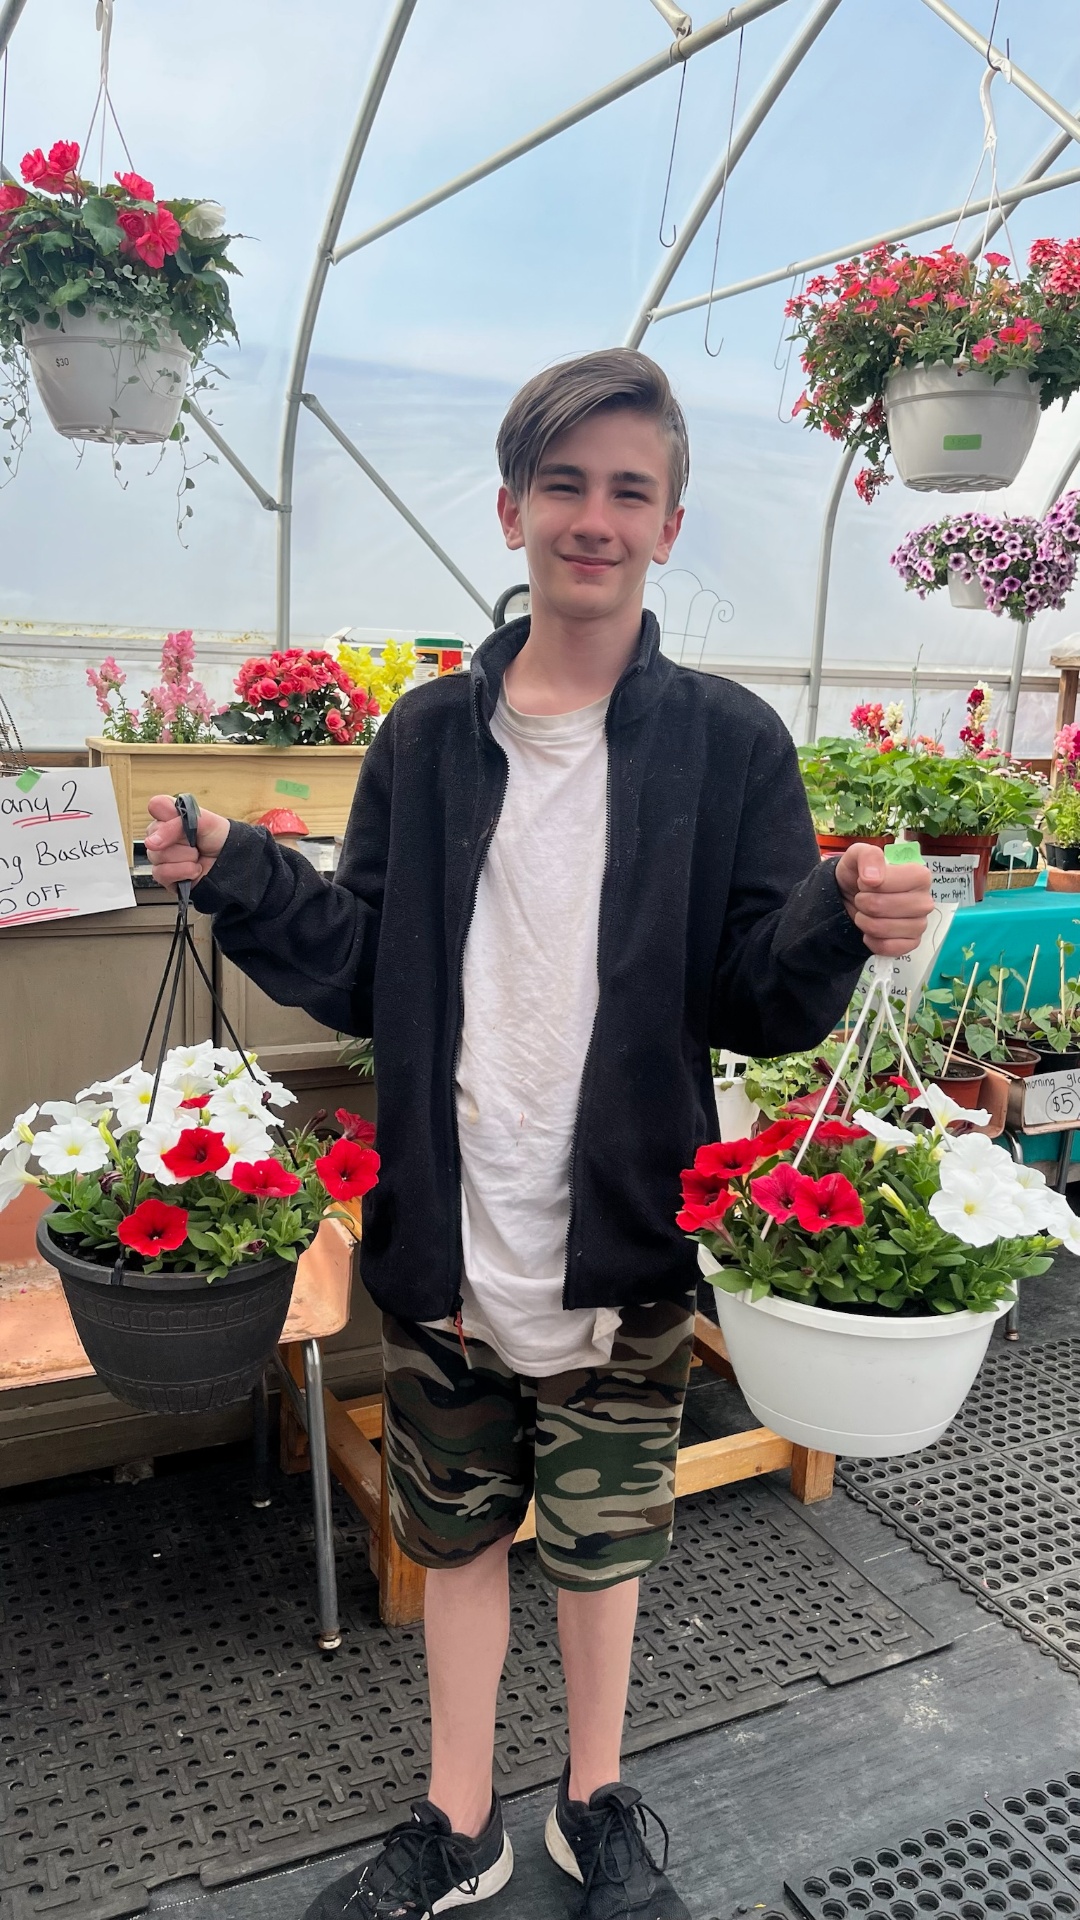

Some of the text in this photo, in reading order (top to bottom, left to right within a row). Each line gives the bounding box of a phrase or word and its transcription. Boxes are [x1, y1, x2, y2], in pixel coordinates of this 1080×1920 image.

[55, 357, 70, 368] $30
[1, 780, 93, 821] any 2
[36, 838, 119, 866] Baskets
[932, 874, 971, 889] nebearing)
[26, 884, 67, 907] OFF
[1052, 1092, 1074, 1115] $5
